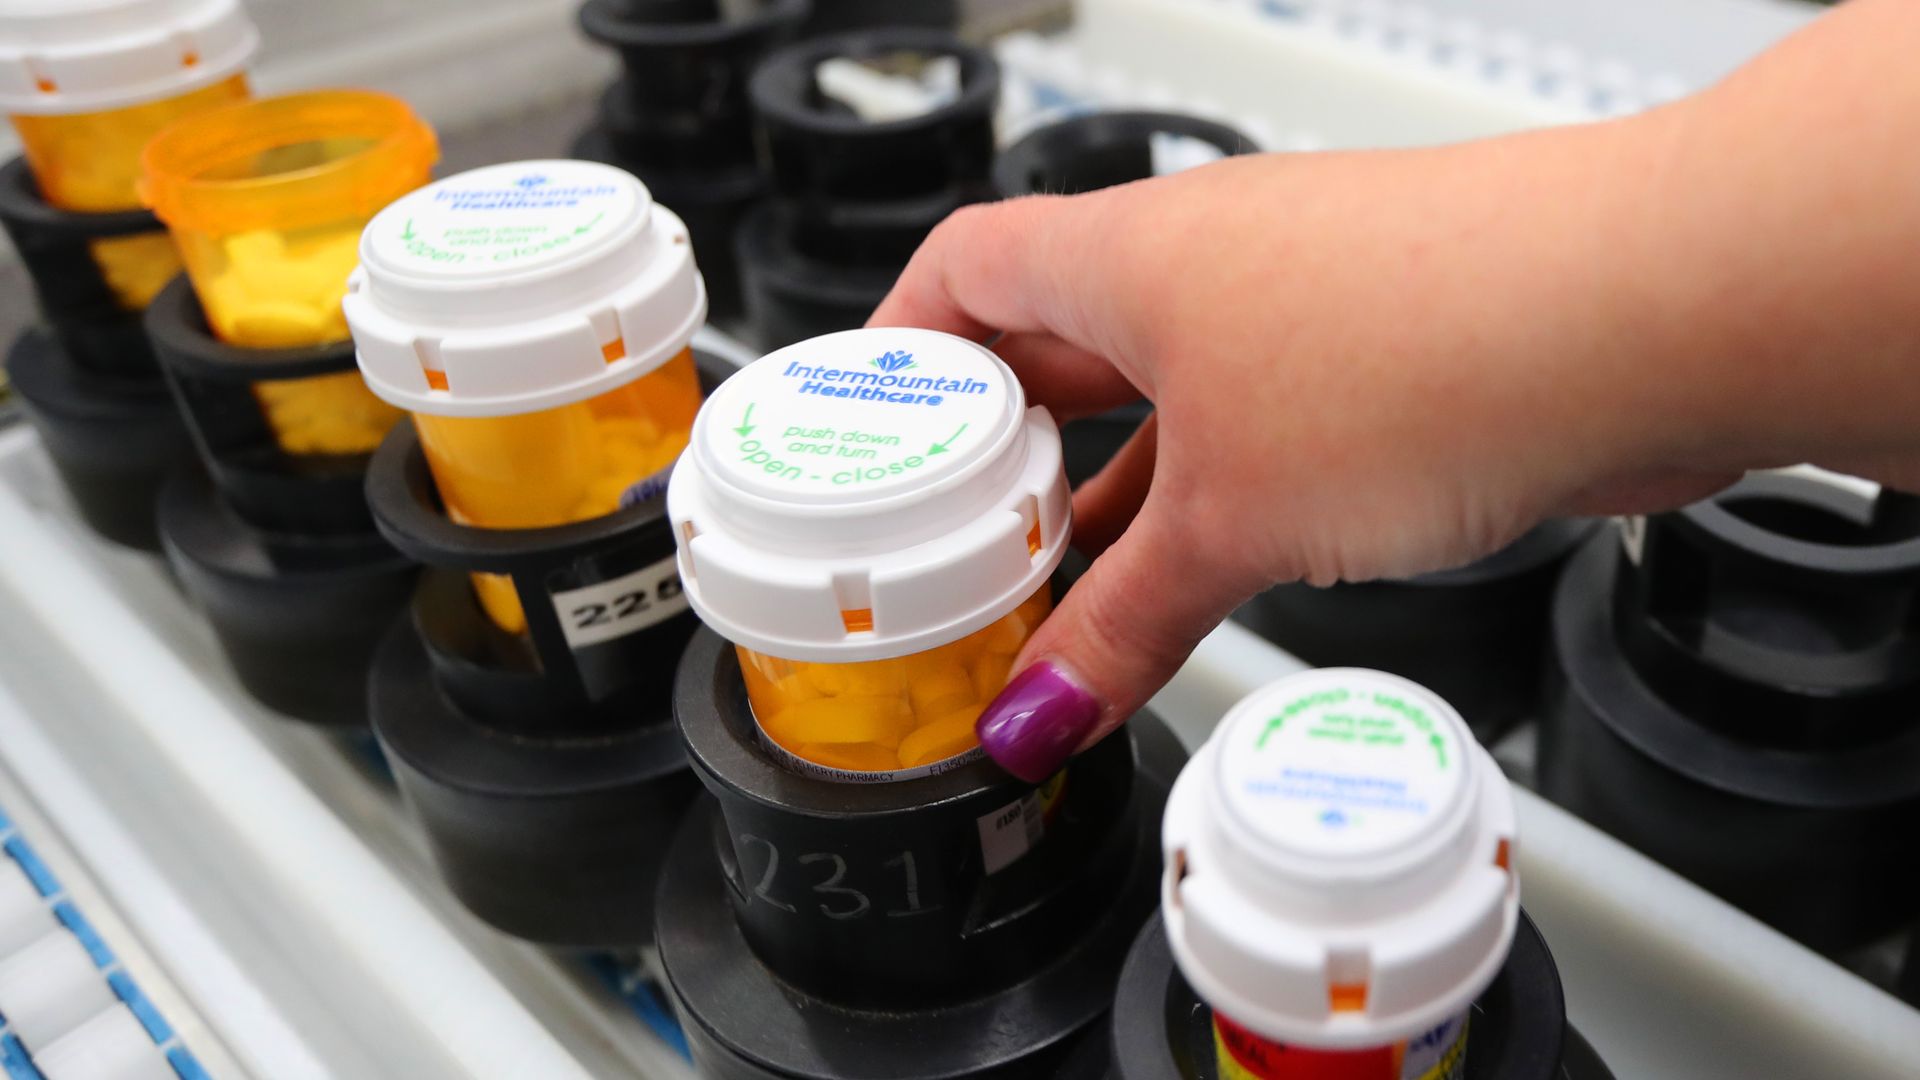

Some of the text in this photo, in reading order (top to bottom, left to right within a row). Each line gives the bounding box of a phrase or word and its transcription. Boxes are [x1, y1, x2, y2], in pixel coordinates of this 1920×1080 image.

[783, 360, 989, 395] Intermountain
[798, 380, 944, 407] Healthcare
[783, 425, 900, 447] push down
[739, 438, 803, 481] open
[831, 454, 925, 486] close
[787, 440, 877, 460] and turn
[836, 770, 895, 782] PHARMACY
[739, 834, 943, 920] 231
